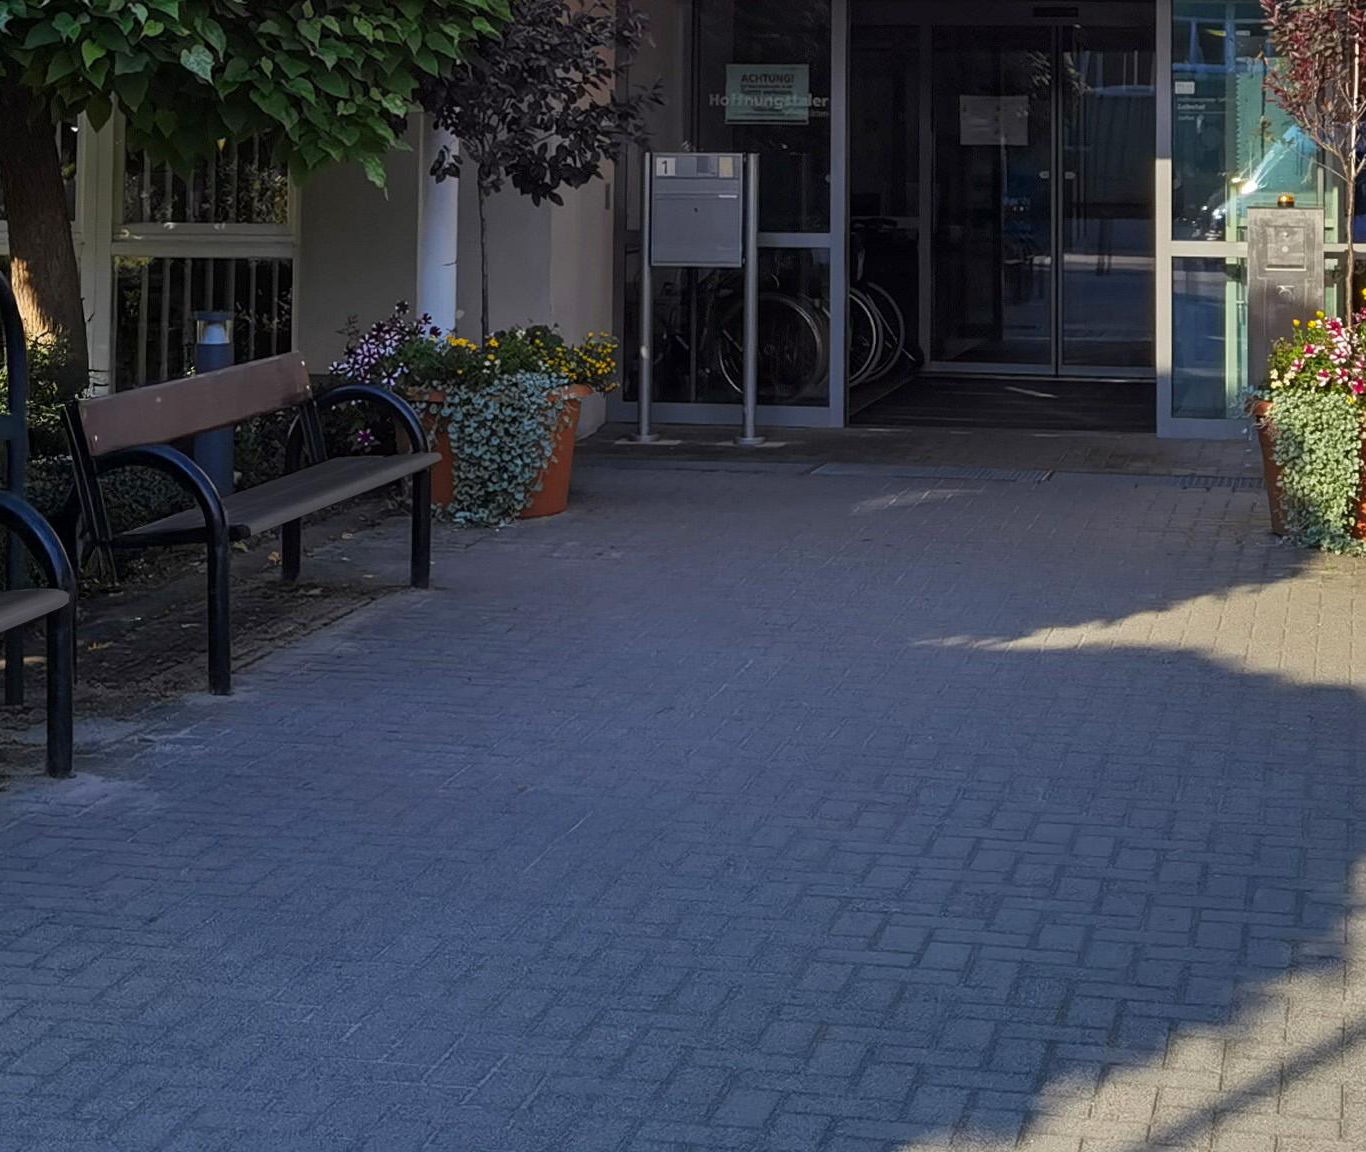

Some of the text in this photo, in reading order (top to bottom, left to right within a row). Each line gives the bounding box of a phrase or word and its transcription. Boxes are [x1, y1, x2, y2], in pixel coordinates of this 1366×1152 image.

[741, 74, 795, 84] ACHTUNG!
[709, 93, 828, 109] Hoffnungstaler
[661, 160, 668, 175] 1
